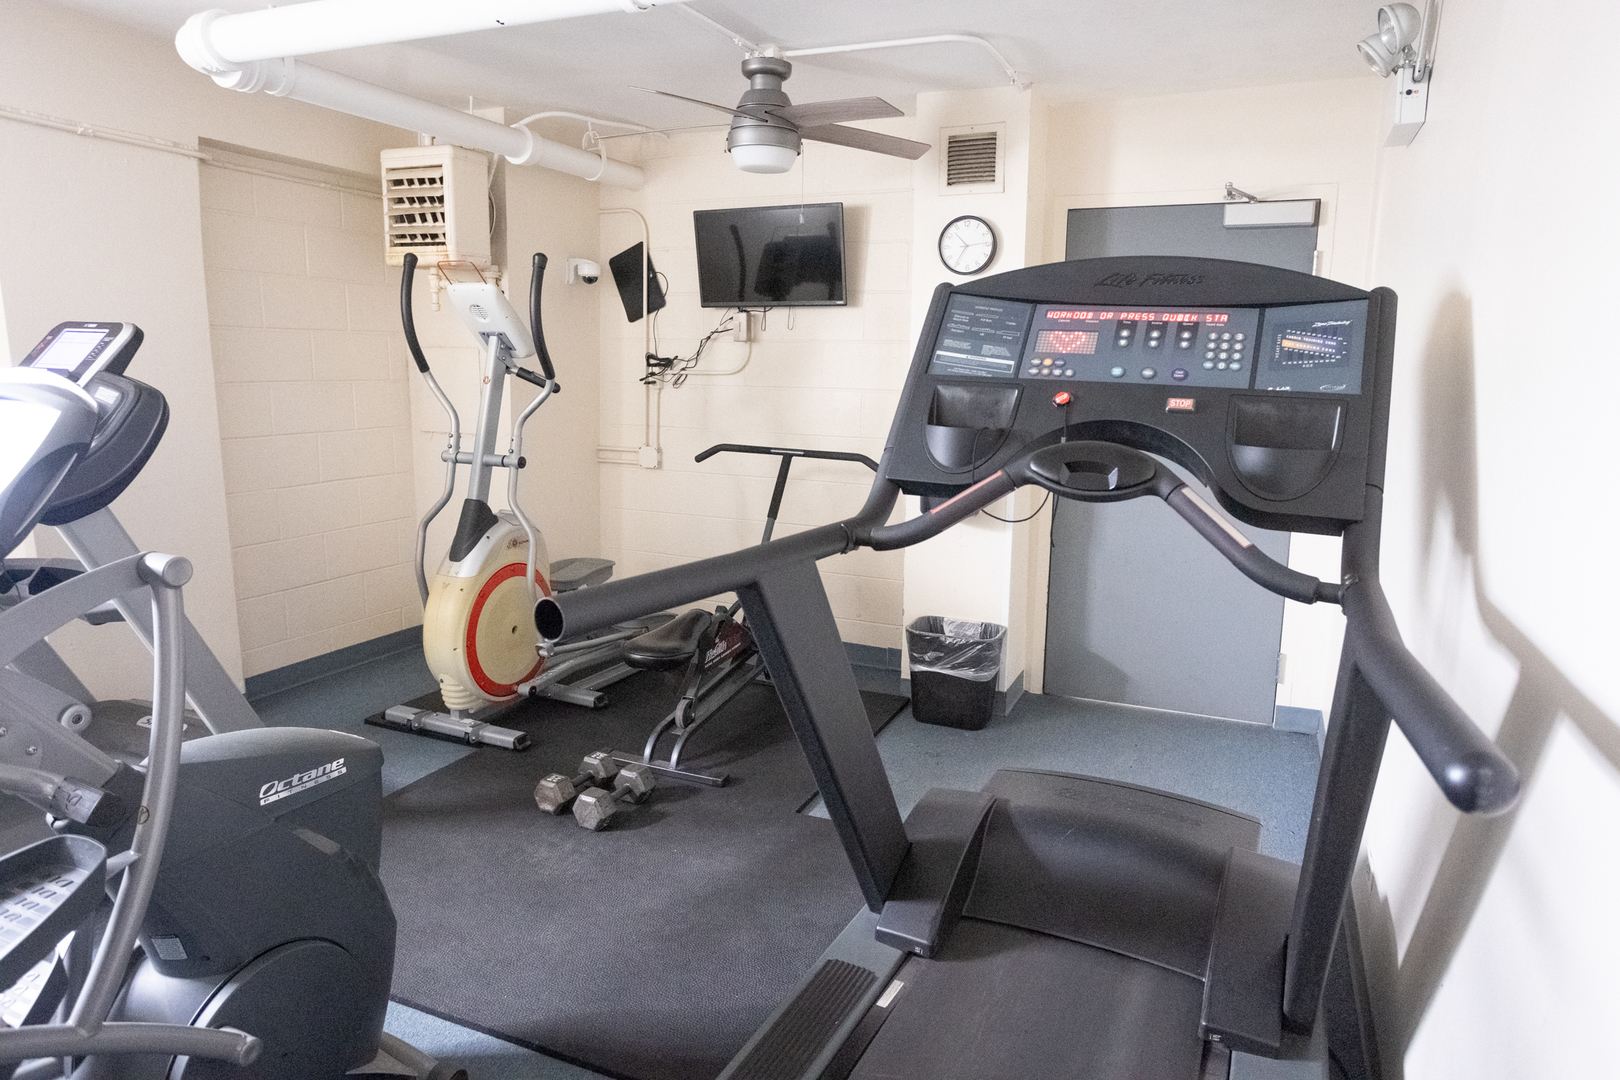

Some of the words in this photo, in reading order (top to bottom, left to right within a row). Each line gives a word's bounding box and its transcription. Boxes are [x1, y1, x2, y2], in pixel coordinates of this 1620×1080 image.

[964, 220, 971, 228] 12
[965, 264, 970, 272] 6
[1100, 312, 1114, 320] OR
[1120, 312, 1156, 321] PRESS
[1206, 314, 1229, 322] STA
[259, 758, 345, 798] Octane
[263, 769, 344, 804] FITNESS
